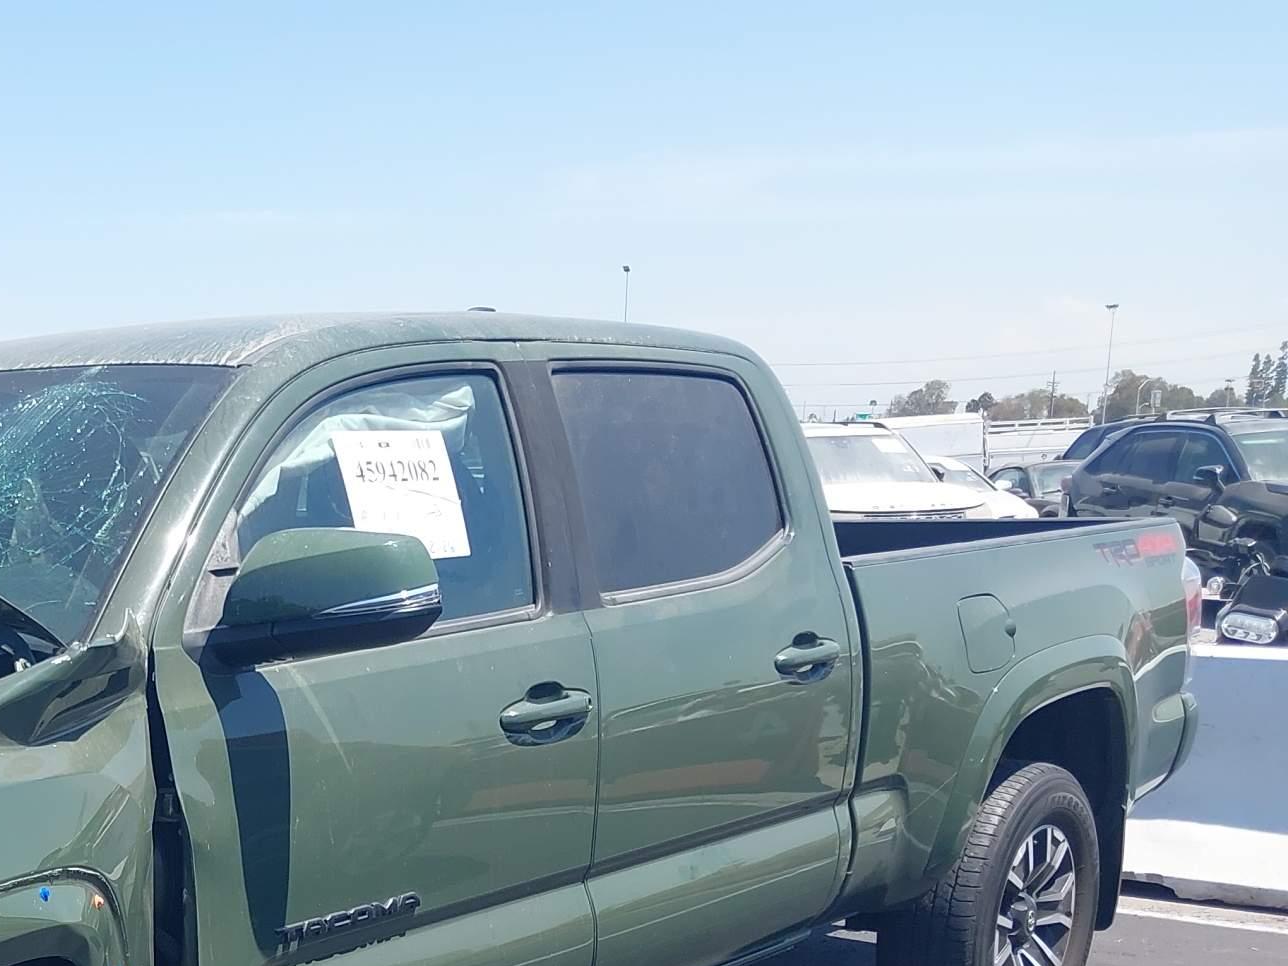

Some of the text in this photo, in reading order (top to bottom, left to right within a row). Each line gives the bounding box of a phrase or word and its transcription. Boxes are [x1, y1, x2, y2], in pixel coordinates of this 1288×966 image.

[355, 459, 440, 483] 45942082
[1093, 538, 1141, 568] TRD
[274, 891, 421, 954] TACOMA
